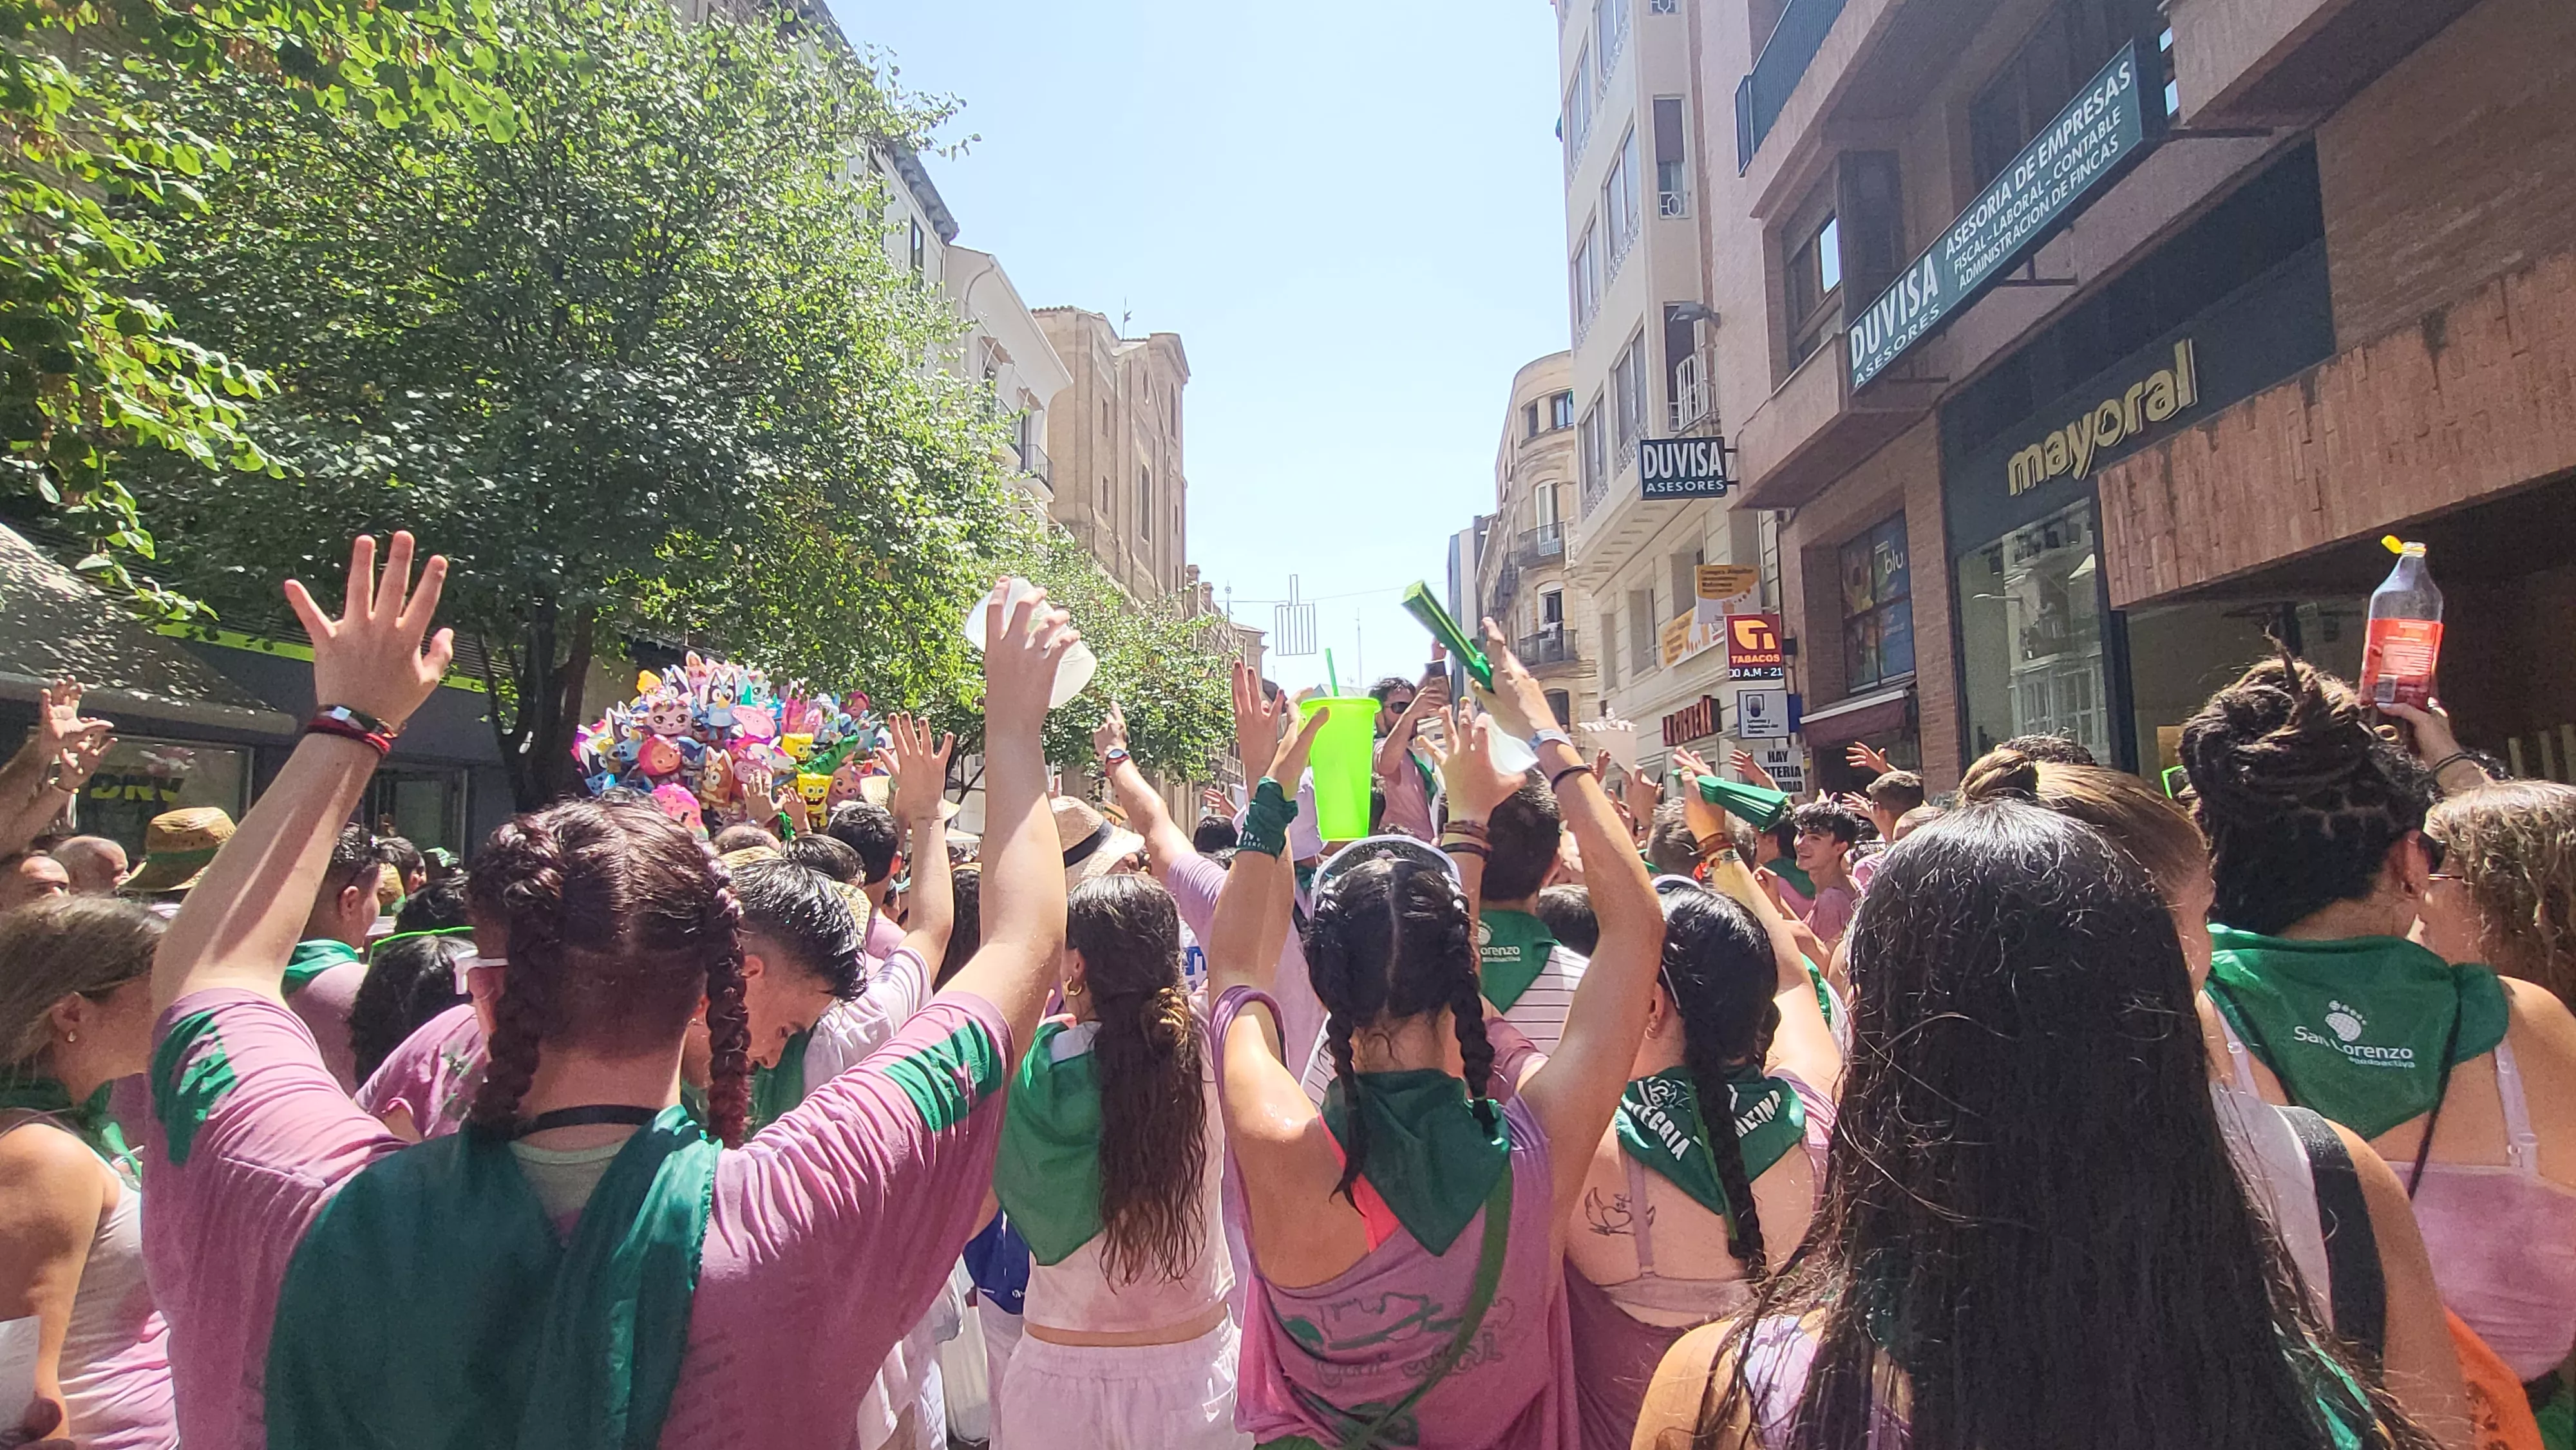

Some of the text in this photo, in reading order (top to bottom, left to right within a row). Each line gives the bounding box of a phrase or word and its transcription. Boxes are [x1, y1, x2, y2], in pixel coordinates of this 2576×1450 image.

[1946, 61, 2130, 261] ASESORIA DE EMPRESAS
[1954, 235, 1987, 274] FISCAL
[1993, 180, 2044, 237] LABORAL
[2053, 106, 2121, 179] CONTABLE
[1960, 133, 2119, 291] ADMINISTRACION DE FINCAS
[1851, 253, 1938, 371] DUVISA
[1855, 303, 1940, 388] ASESORES
[2007, 338, 2197, 496] mayoral
[1643, 442, 1723, 479] DUVISA
[1646, 480, 1725, 493] ASESORES
[1731, 654, 1780, 664] TABACOS
[1770, 667, 1783, 677] 21
[1763, 766, 1801, 778] OTERIA
[1768, 751, 1788, 763] HAY
[1480, 946, 1520, 956] orenzo
[2293, 1026, 2414, 1059] San Lorenzo
